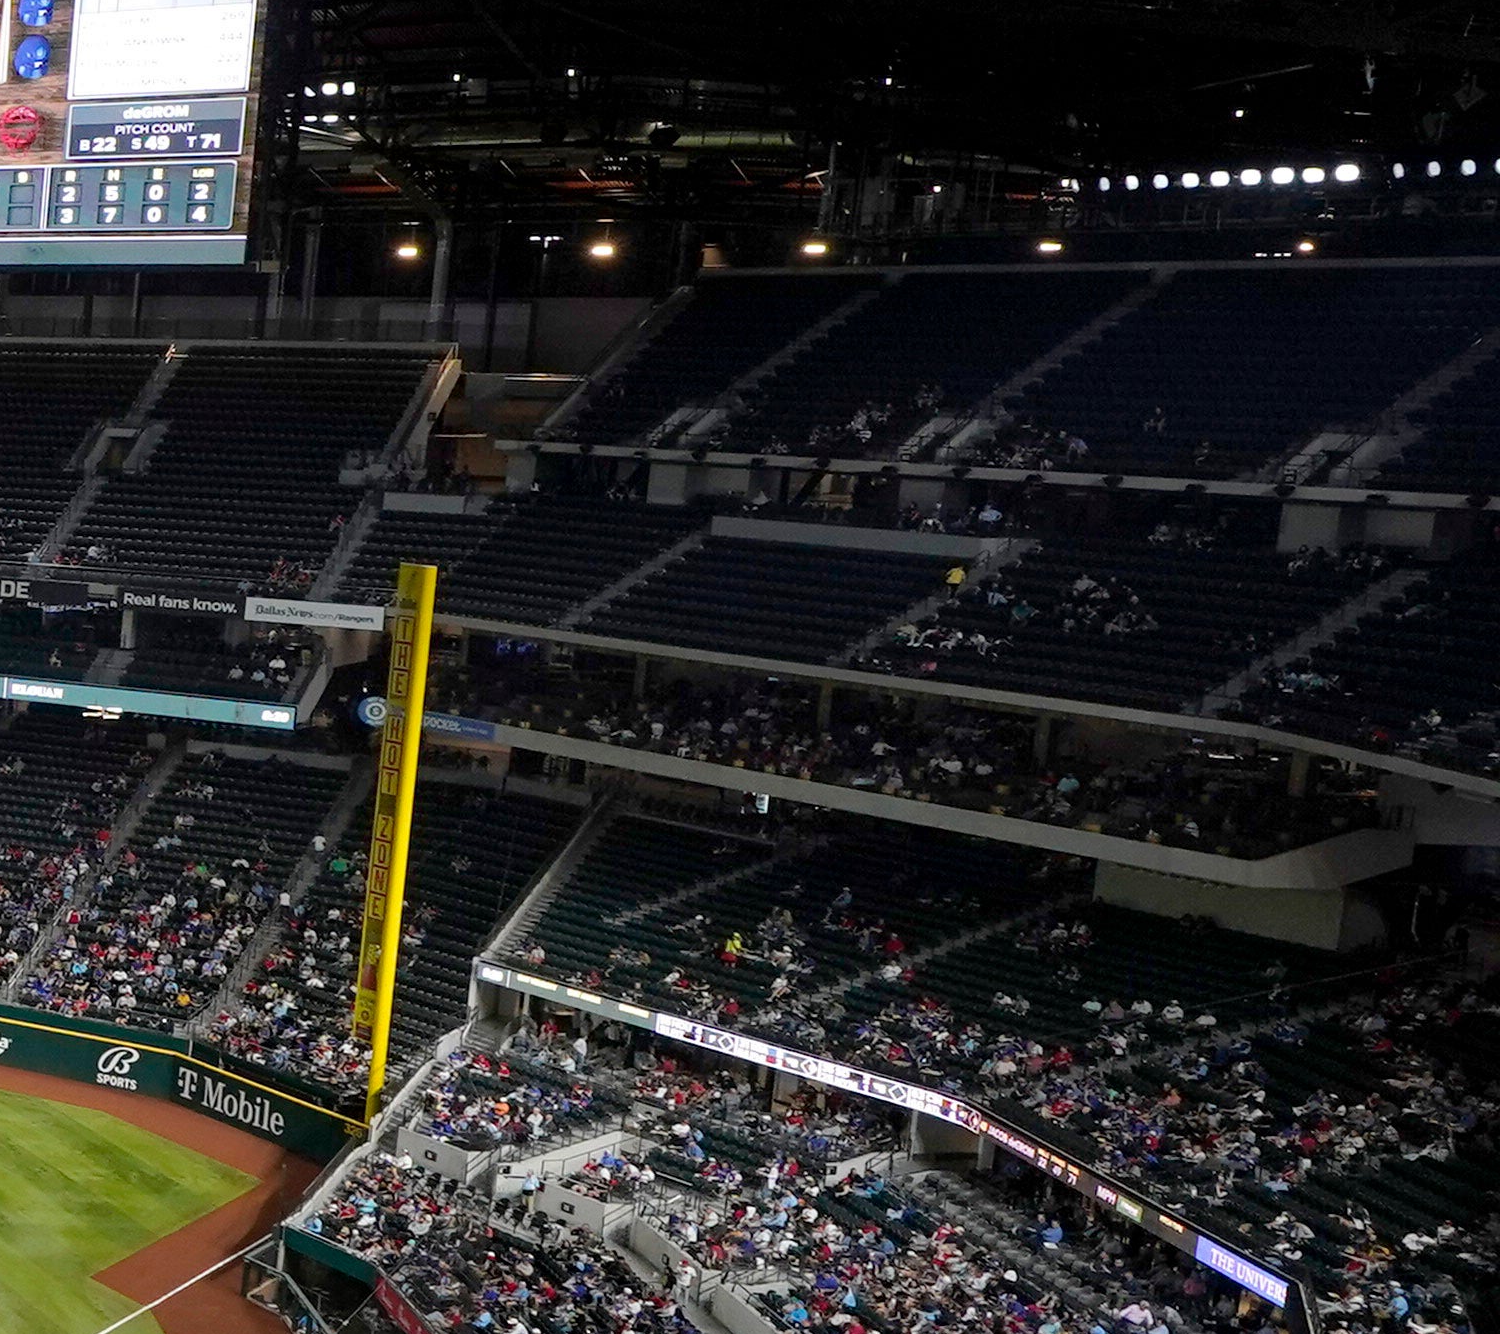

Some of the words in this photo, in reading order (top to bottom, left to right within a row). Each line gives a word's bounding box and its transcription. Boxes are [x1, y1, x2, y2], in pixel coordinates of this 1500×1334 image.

[122, 105, 190, 120] deGROM
[114, 124, 150, 136] PITCH
[152, 122, 195, 134] COUNT
[92, 137, 117, 152] 22
[144, 136, 170, 150] 49
[199, 134, 221, 149] 71
[124, 592, 155, 608] Real
[158, 593, 190, 610] fans
[193, 598, 238, 614] know.
[256, 603, 287, 618] Dallas
[394, 617, 415, 698] THE
[382, 715, 405, 795] HOT
[368, 814, 393, 920] ZONE
[96, 1072, 138, 1091] SPORTS
[1097, 1185, 1118, 1206] MPH
[1210, 1248, 1235, 1274] THE
